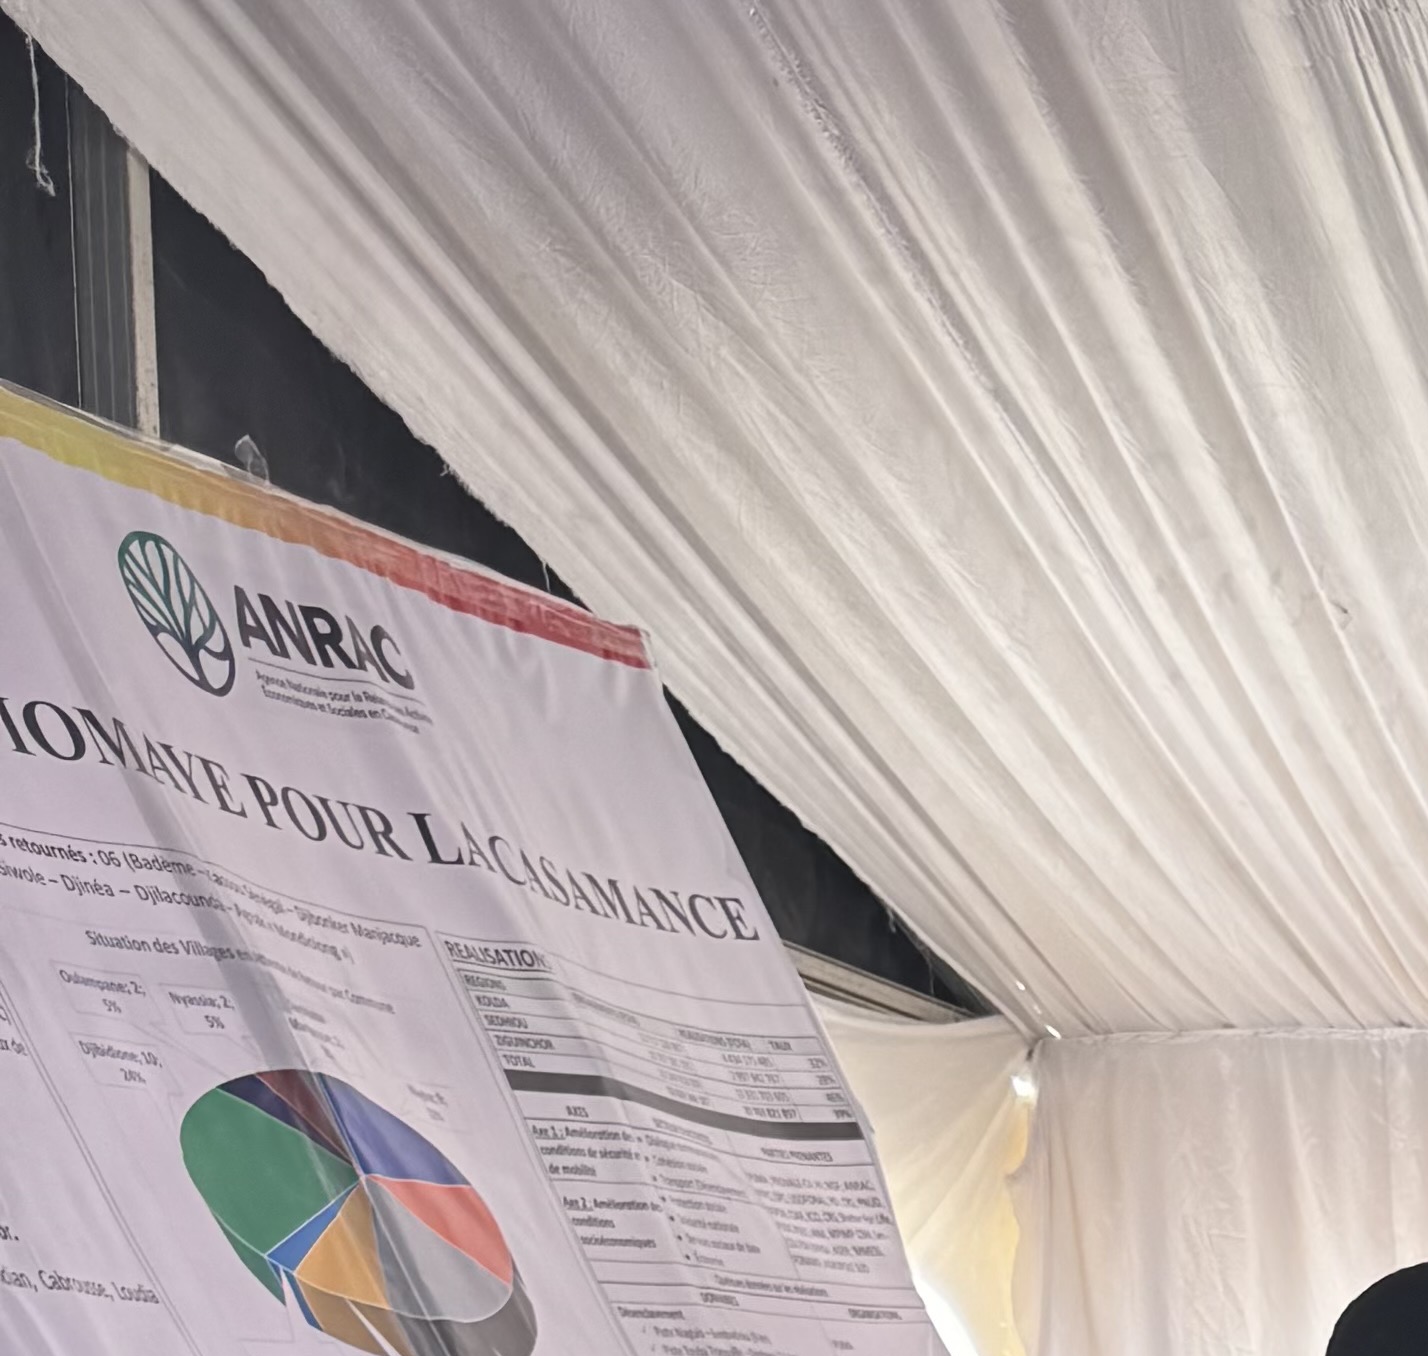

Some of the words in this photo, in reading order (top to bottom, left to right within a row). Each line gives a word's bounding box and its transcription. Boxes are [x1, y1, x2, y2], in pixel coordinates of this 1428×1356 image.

[234, 585, 415, 690] ANRAC
[0, 697, 247, 818] IOMAYE
[241, 773, 413, 861] POUR
[9, 834, 87, 865] retournés
[62, 873, 115, 899] Djinéa
[86, 929, 152, 953] Situation
[154, 936, 180, 956] des
[181, 938, 246, 963] Villages
